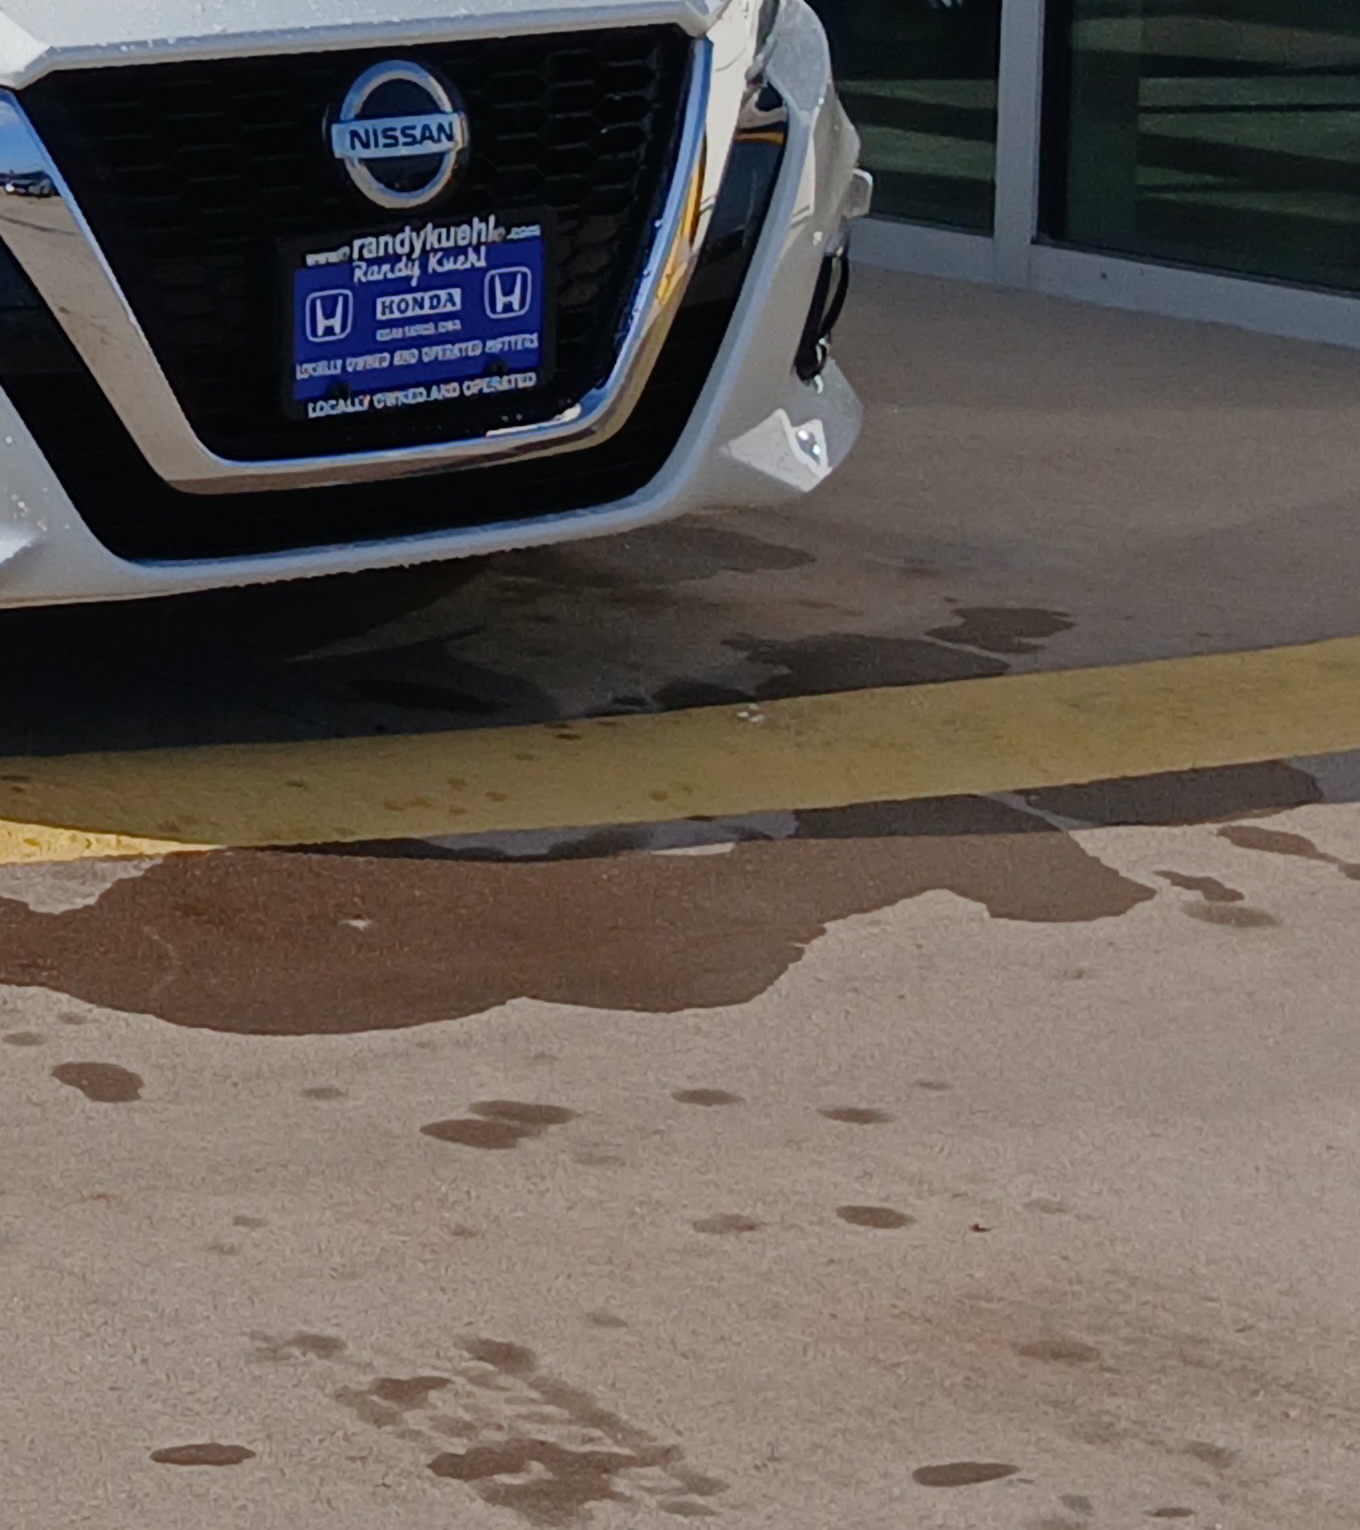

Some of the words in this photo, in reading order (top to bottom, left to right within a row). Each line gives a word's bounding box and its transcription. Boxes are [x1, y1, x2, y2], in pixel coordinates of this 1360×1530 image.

[349, 121, 454, 150] NISSAN
[352, 253, 421, 287] Randy
[427, 245, 488, 274] Kuehl
[380, 291, 458, 317] HONDA
[307, 394, 371, 419] LOCALLY
